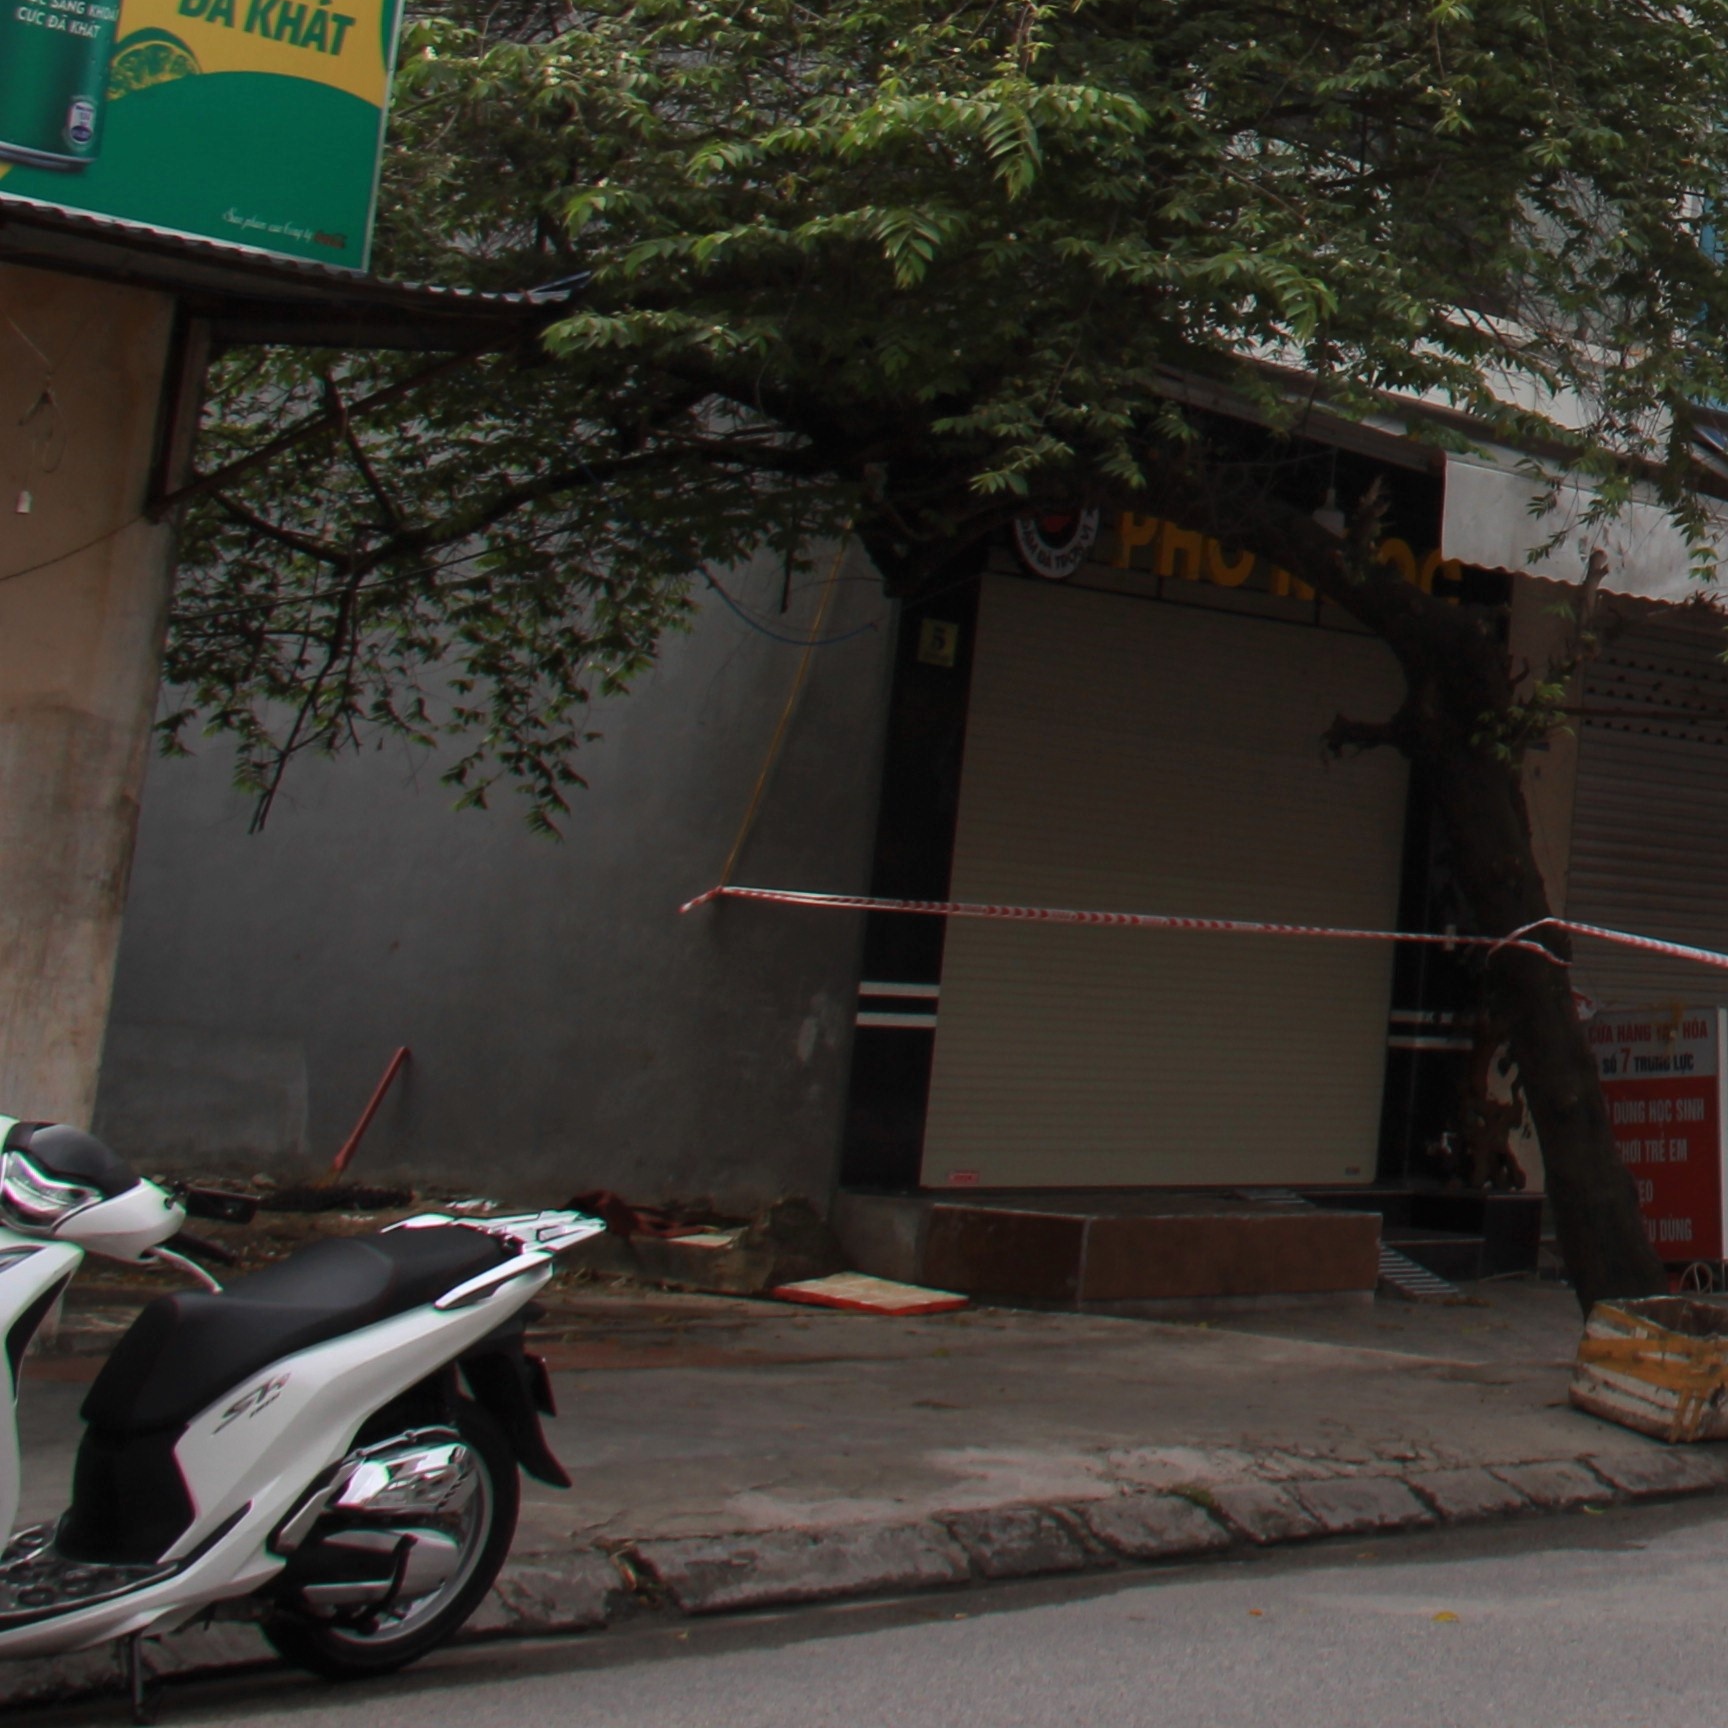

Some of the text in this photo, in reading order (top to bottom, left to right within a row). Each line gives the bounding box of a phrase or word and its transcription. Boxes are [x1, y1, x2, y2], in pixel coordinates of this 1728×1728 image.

[1620, 1048, 1631, 1073] 7
[1613, 1097, 1705, 1129] DÙNG HỌC SINH
[1669, 1137, 1688, 1163] EM
[1638, 1178, 1655, 1208] ẸO
